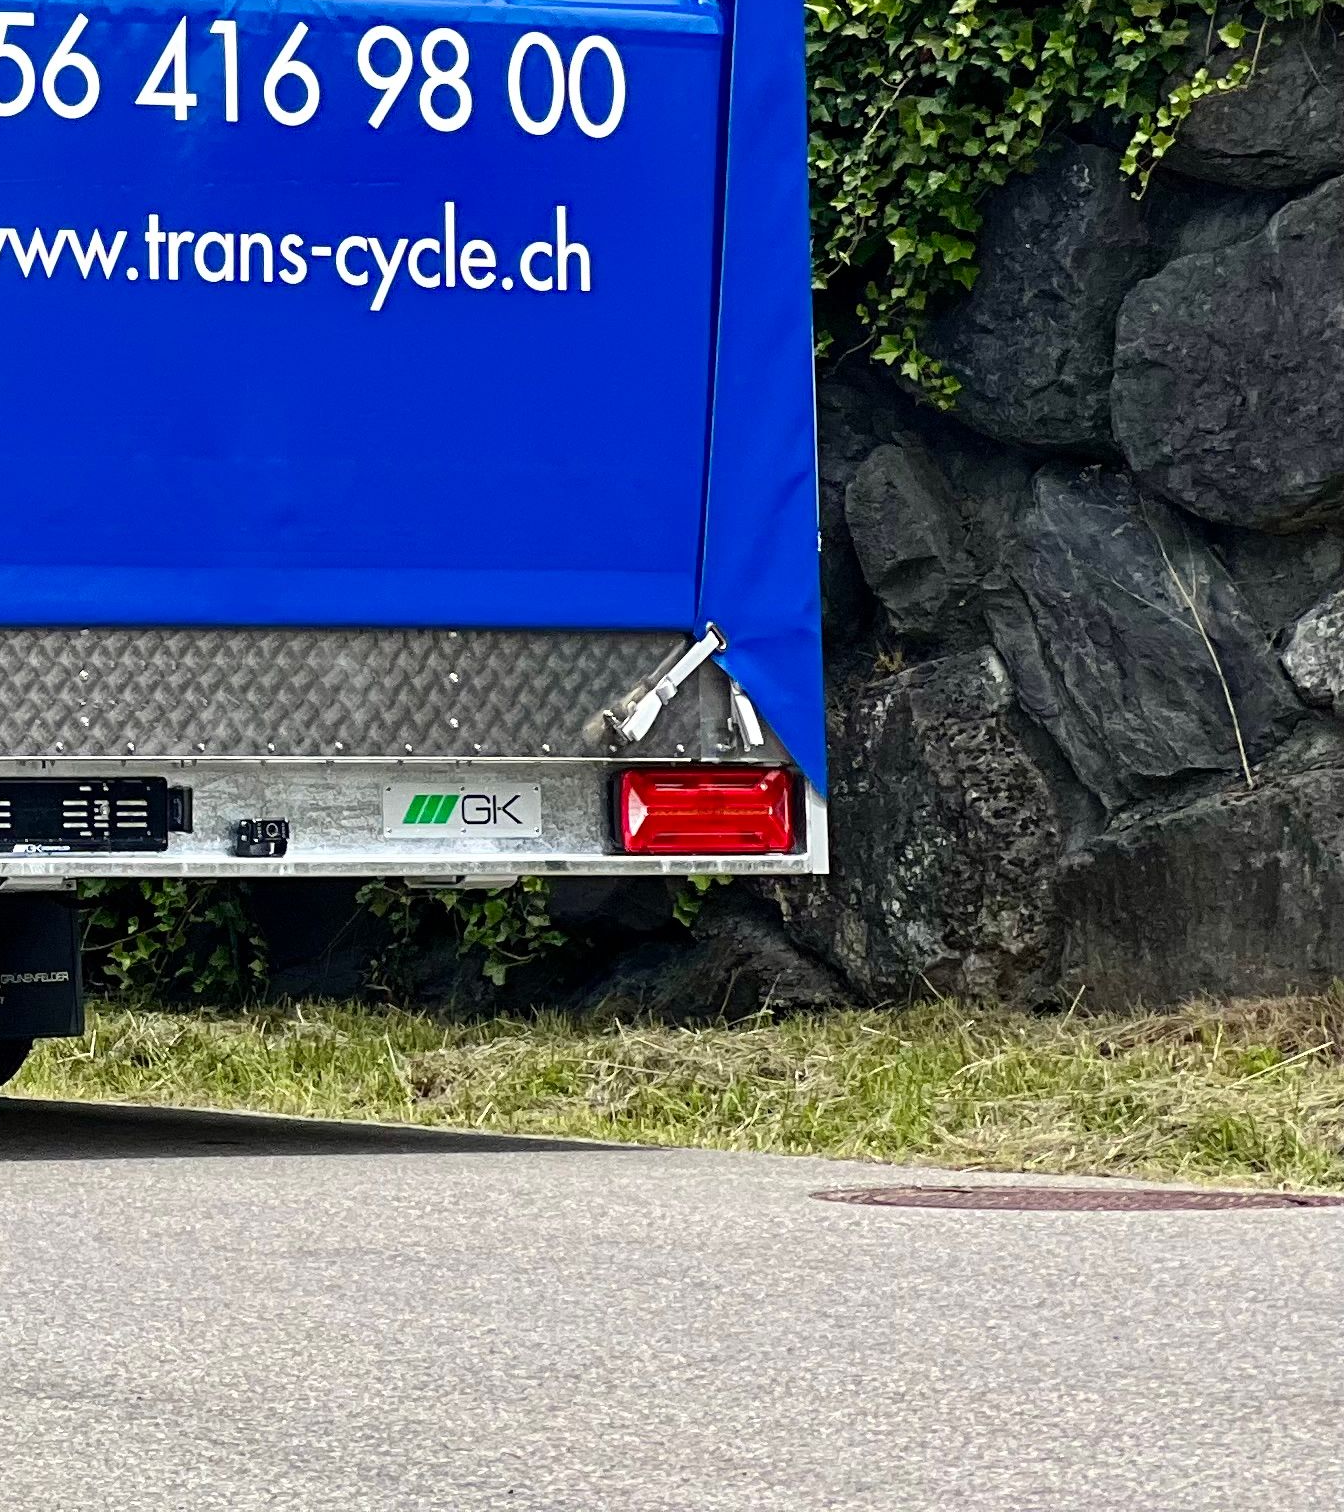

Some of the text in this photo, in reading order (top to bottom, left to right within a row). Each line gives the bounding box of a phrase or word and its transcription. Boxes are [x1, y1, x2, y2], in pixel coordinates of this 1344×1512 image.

[135, 16, 320, 127] 416
[357, 25, 473, 132] 98
[507, 31, 626, 139] 00
[461, 794, 524, 825] GK
